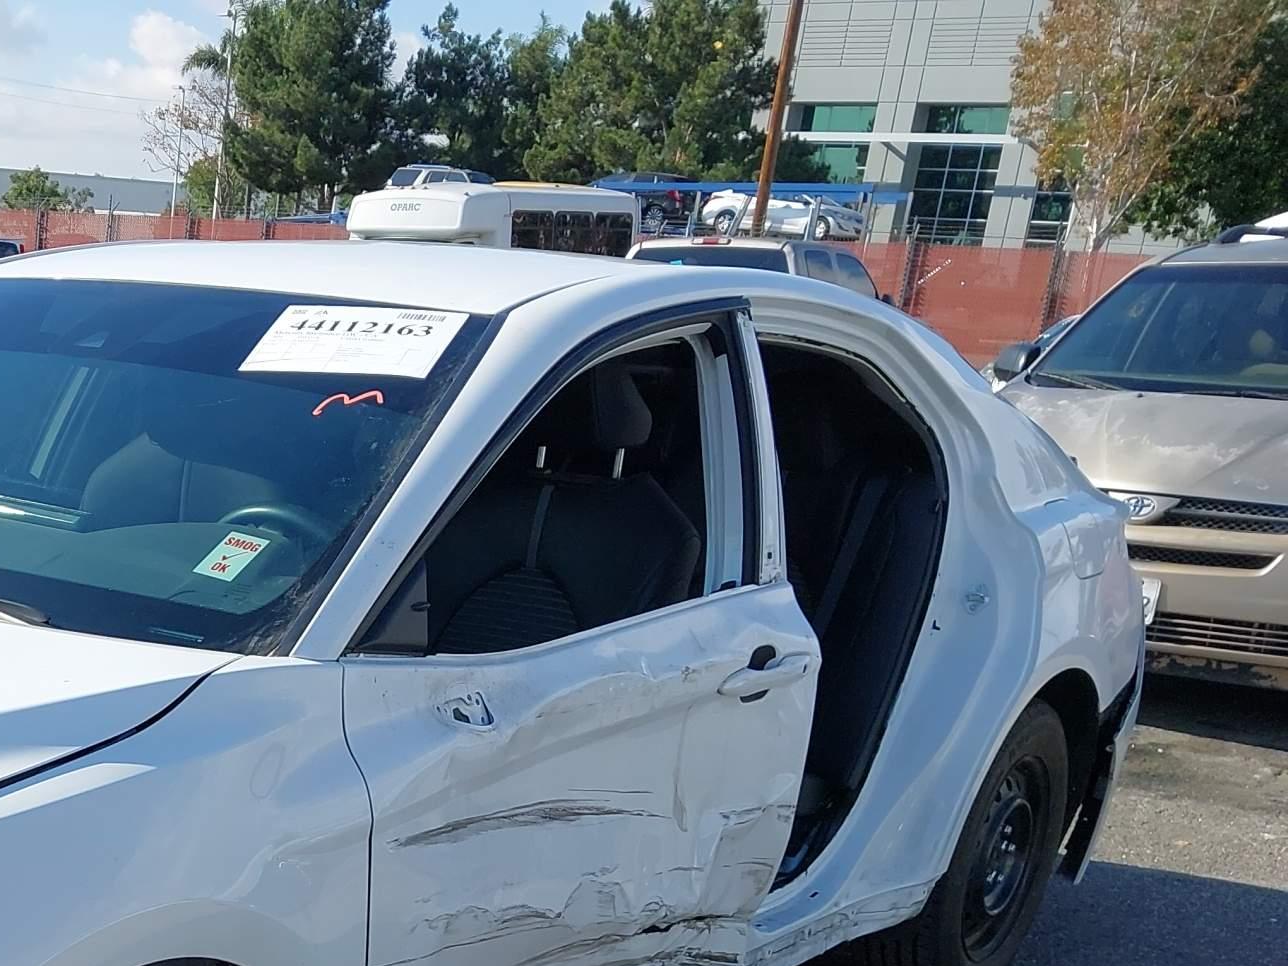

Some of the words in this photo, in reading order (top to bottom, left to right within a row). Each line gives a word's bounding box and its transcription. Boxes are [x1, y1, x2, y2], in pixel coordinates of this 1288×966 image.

[289, 319, 434, 337] 44112163
[224, 536, 262, 553] SMOG
[210, 561, 232, 573] OK
